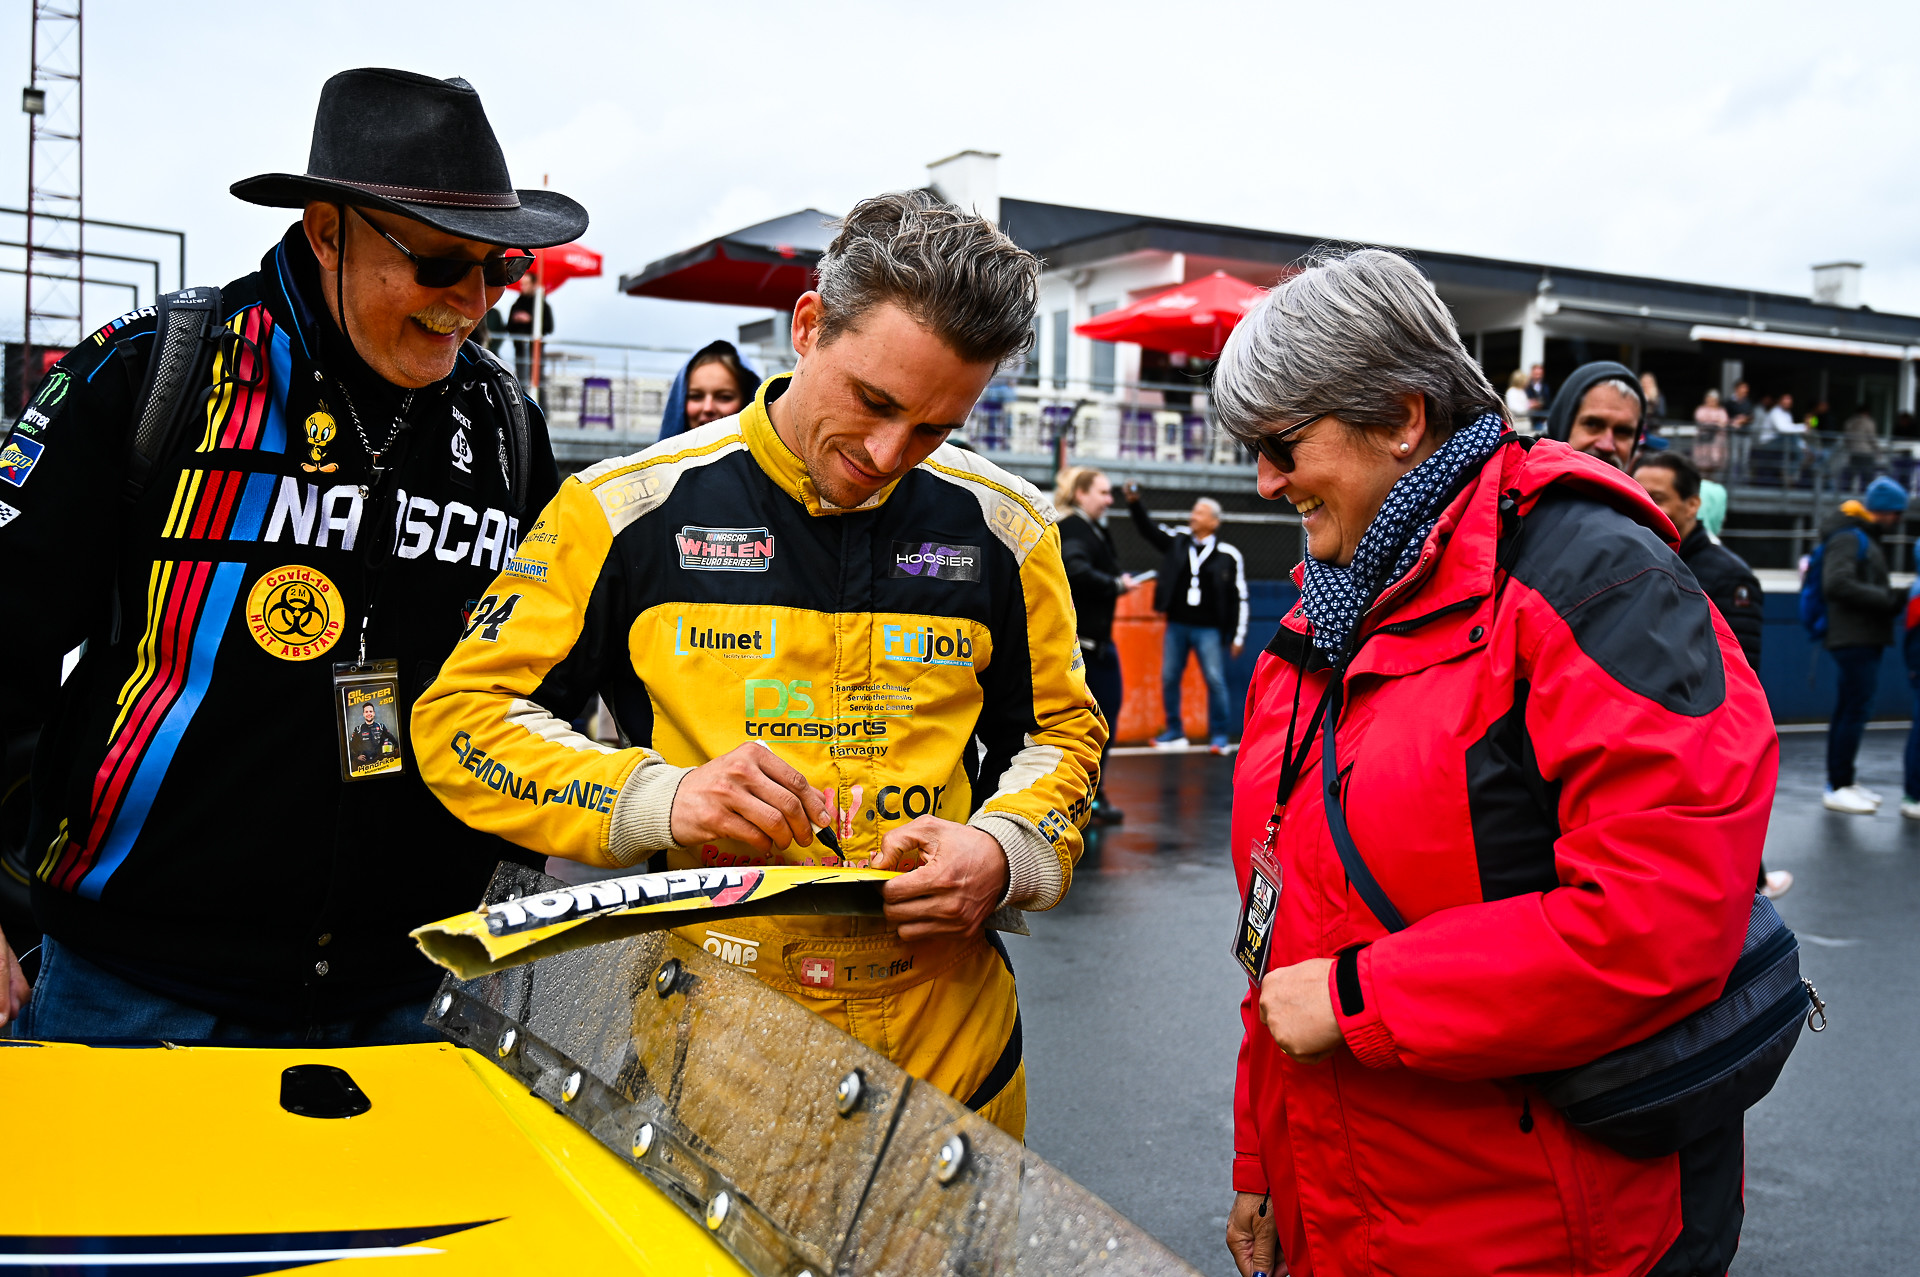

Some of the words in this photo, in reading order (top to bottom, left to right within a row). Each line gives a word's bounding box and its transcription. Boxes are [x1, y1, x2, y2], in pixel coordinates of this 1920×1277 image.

[456, 433, 469, 458] 13
[605, 477, 661, 510] OMP
[995, 504, 1038, 544] OMP
[680, 536, 773, 558] WHELEN
[716, 533, 748, 542] NASCAR
[701, 557, 723, 566] EURO
[723, 558, 752, 567] SERIES
[896, 553, 974, 567] HOOSIER
[266, 569, 330, 594] Covid-19
[290, 588, 298, 597] 2
[298, 589, 306, 598] M
[460, 593, 524, 643] 34
[250, 613, 277, 648] HALT
[280, 620, 340, 657] ABSTAND
[883, 624, 973, 664] Frijob
[347, 687, 392, 707] LINSTER
[348, 689, 365, 700] GIL
[744, 679, 816, 719] DS
[881, 683, 911, 693] chantier
[745, 720, 887, 740] transports
[1247, 925, 1262, 951] VIP
[703, 937, 758, 967] OMP
[843, 966, 859, 982] T.
